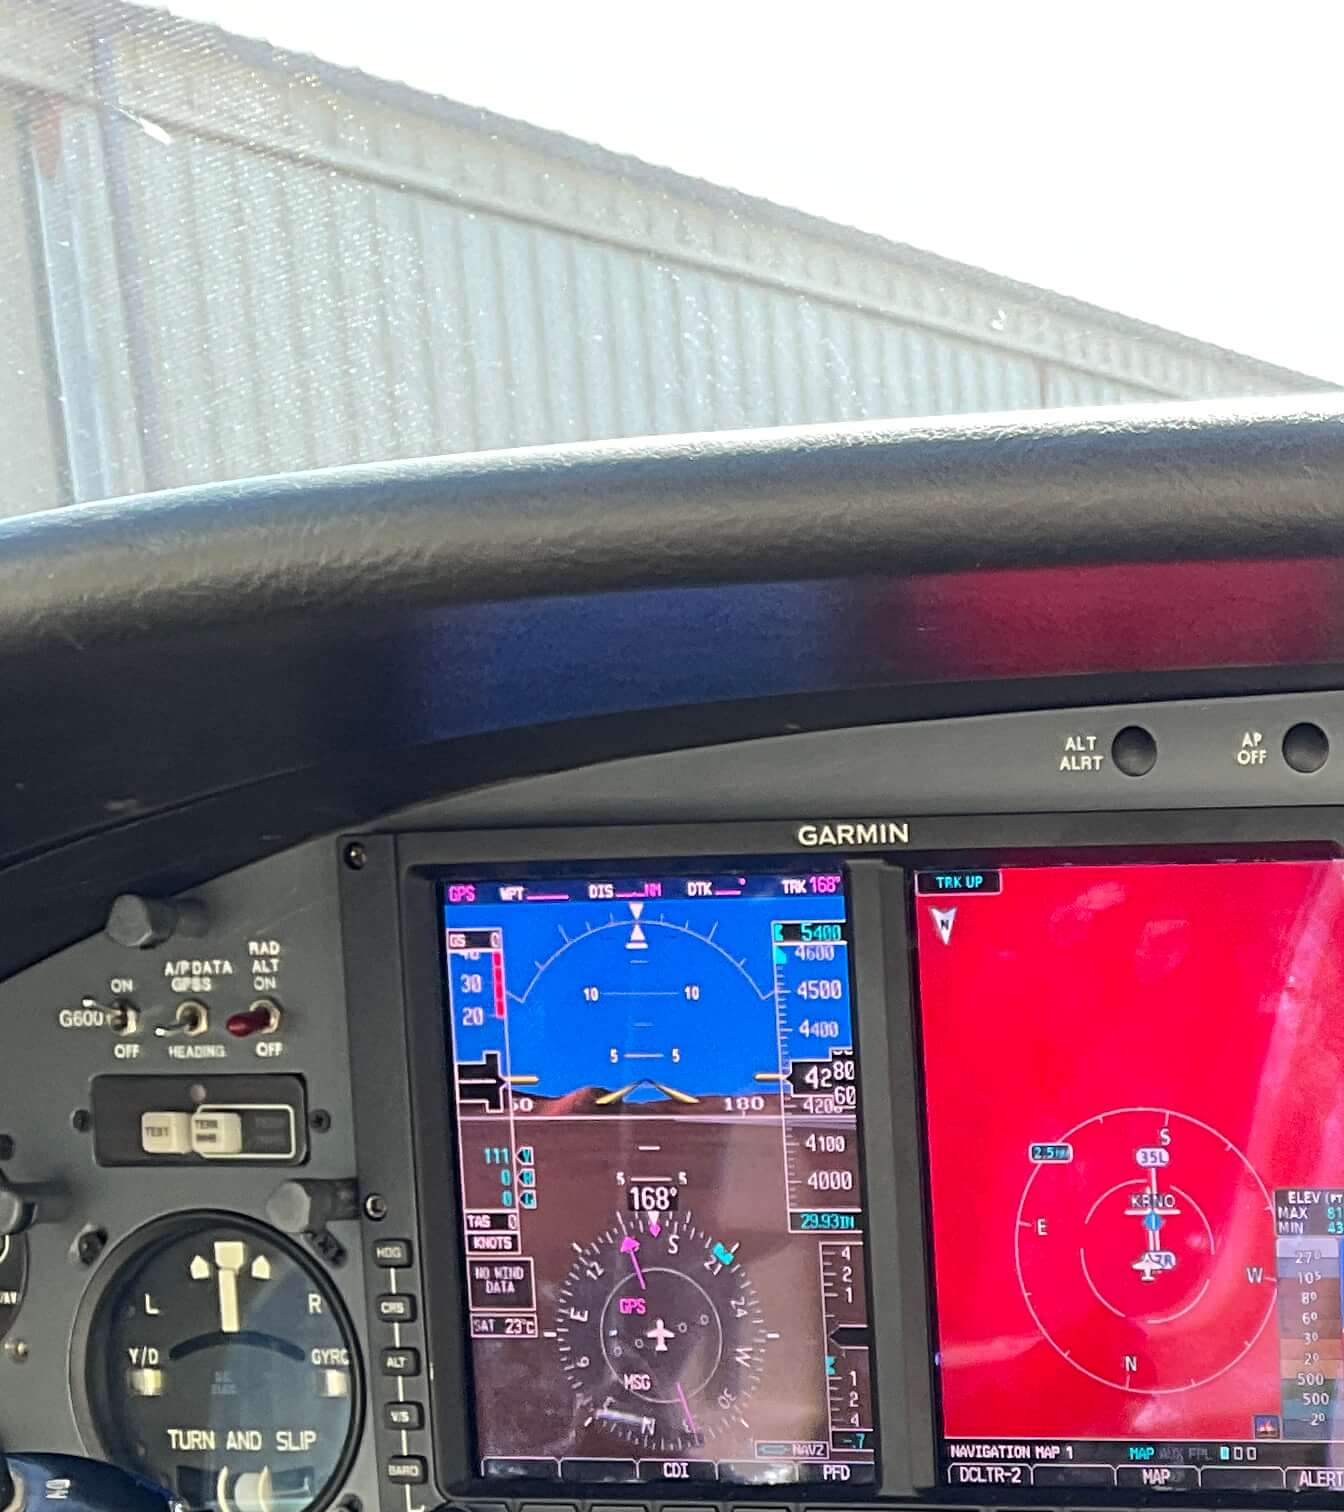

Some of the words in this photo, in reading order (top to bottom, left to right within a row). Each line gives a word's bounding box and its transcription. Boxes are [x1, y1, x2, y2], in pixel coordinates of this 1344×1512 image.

[1066, 736, 1096, 751] ALT
[1242, 733, 1262, 747] AP
[1060, 755, 1103, 771] ALRT
[1238, 749, 1267, 765] OFF
[798, 824, 909, 847] GARMIN
[936, 874, 962, 890] TRK
[966, 874, 983, 889] UP
[797, 980, 841, 999] 4500
[808, 1171, 852, 1191] 4000
[473, 1236, 512, 1250] KNOTS
[168, 1430, 215, 1452] TURN
[226, 1430, 263, 1452] AND
[276, 1432, 317, 1452] SLIP
[949, 1444, 1031, 1460] NAVIGATION
[1035, 1444, 1061, 1460] MAP
[1067, 1445, 1073, 1460] 1
[663, 1462, 689, 1479] CDI
[823, 1465, 850, 1481] PFD
[959, 1467, 1022, 1484] DCLTR-2
